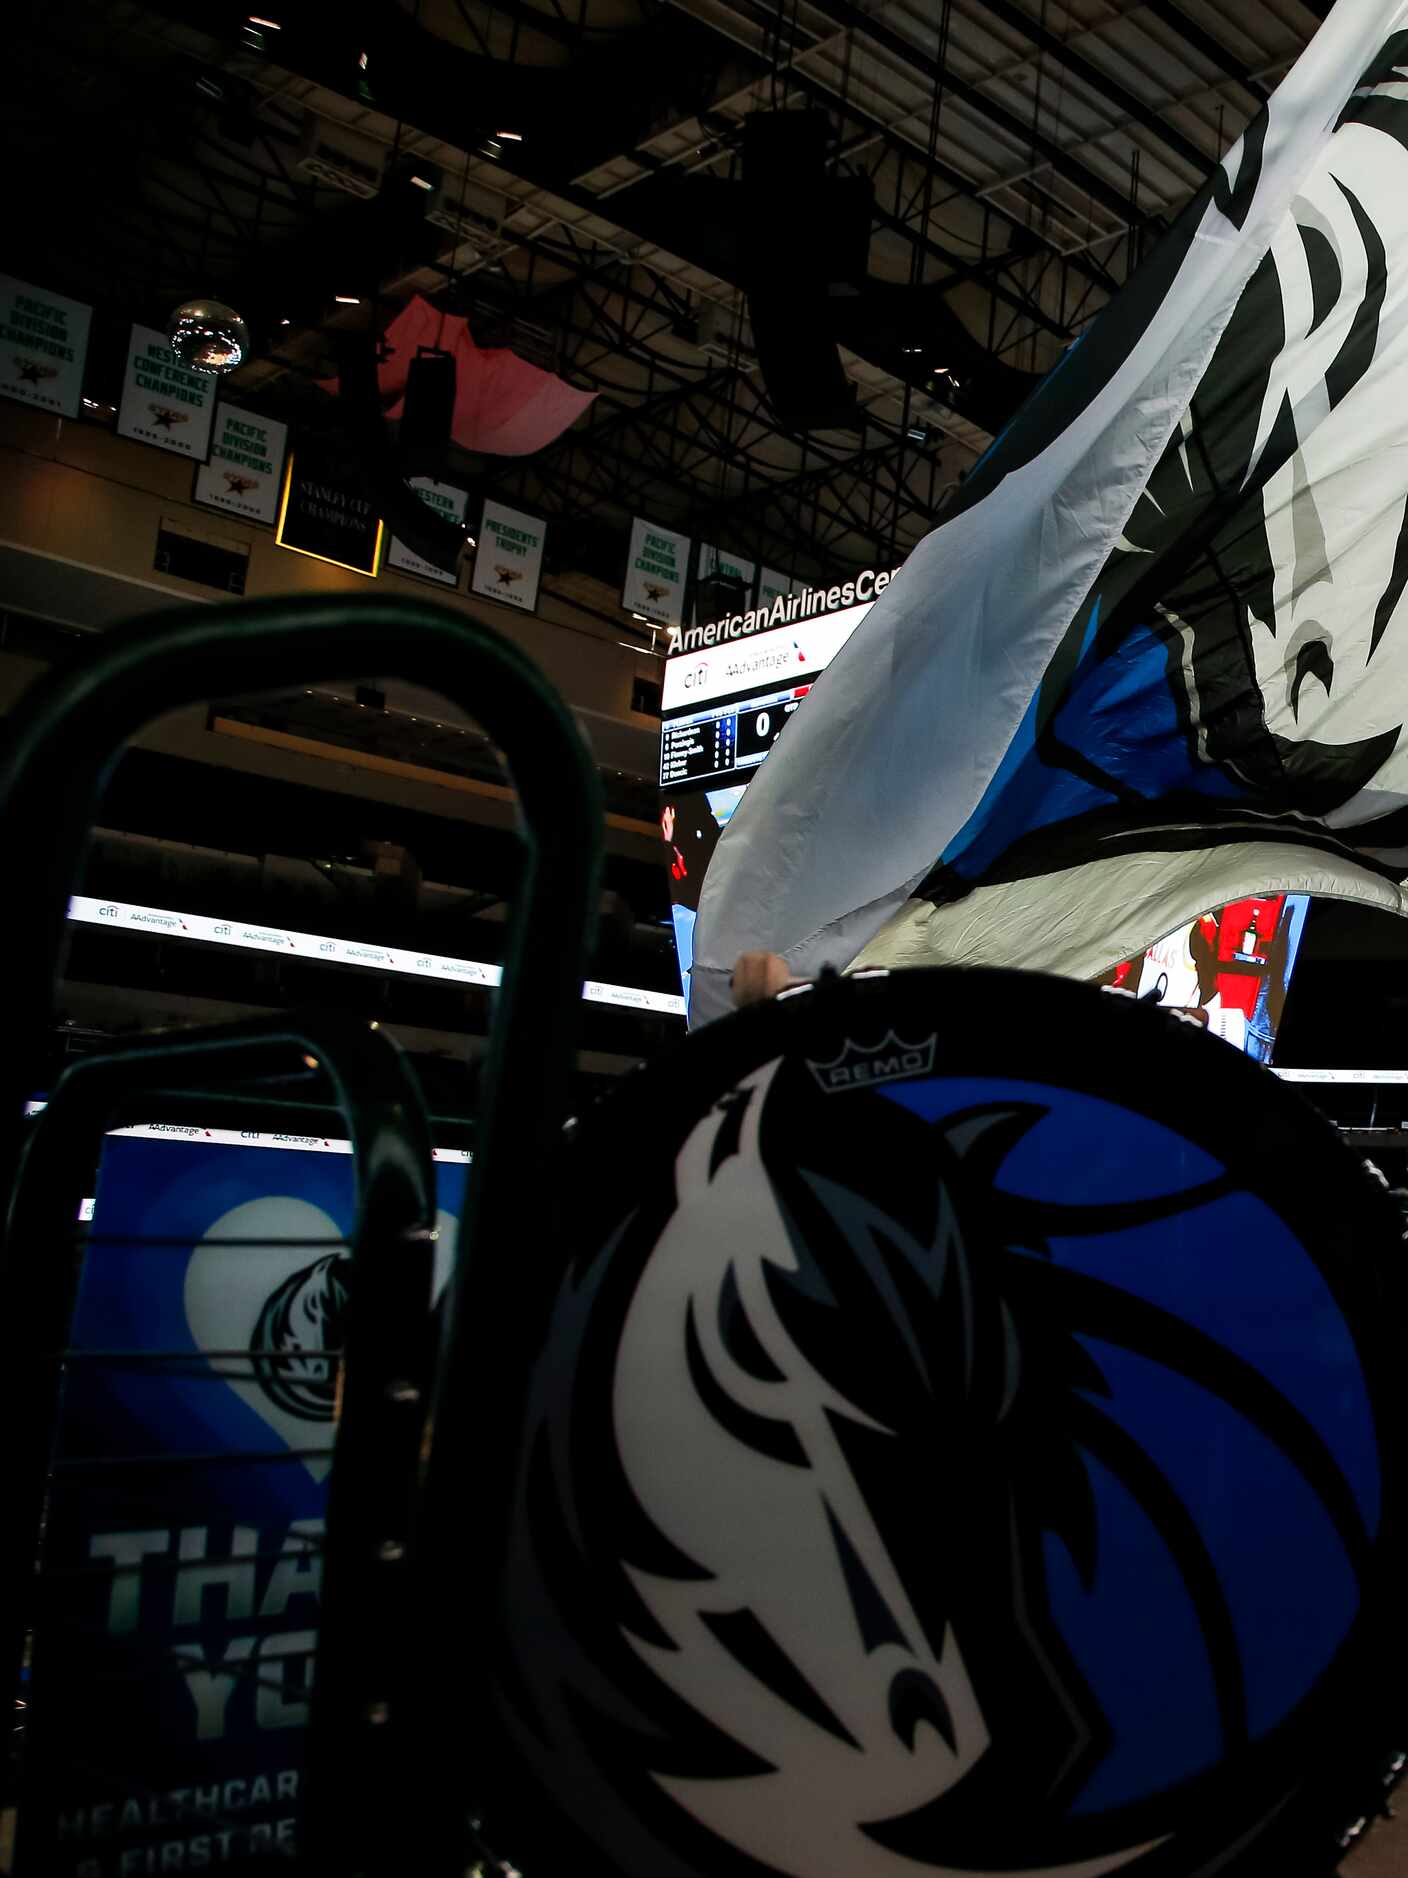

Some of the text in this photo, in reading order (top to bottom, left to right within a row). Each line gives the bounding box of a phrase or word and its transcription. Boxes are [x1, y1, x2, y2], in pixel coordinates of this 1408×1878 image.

[134, 356, 209, 394] CONFERENCE
[136, 374, 204, 408] CHAMPIONS
[222, 432, 267, 457] DIVISION
[226, 418, 267, 443] PACIFIC
[211, 445, 273, 475] CHAMPIONS
[642, 546, 676, 568] DIVISION
[645, 534, 676, 554] PACIFIC
[635, 558, 680, 584] CHAMPIONS
[756, 712, 770, 736] 0
[830, 1052, 923, 1085] REMO
[88, 1518, 326, 1636] THA
[168, 1627, 319, 1741] YO
[56, 1768, 300, 1842] HEALTHCAR
